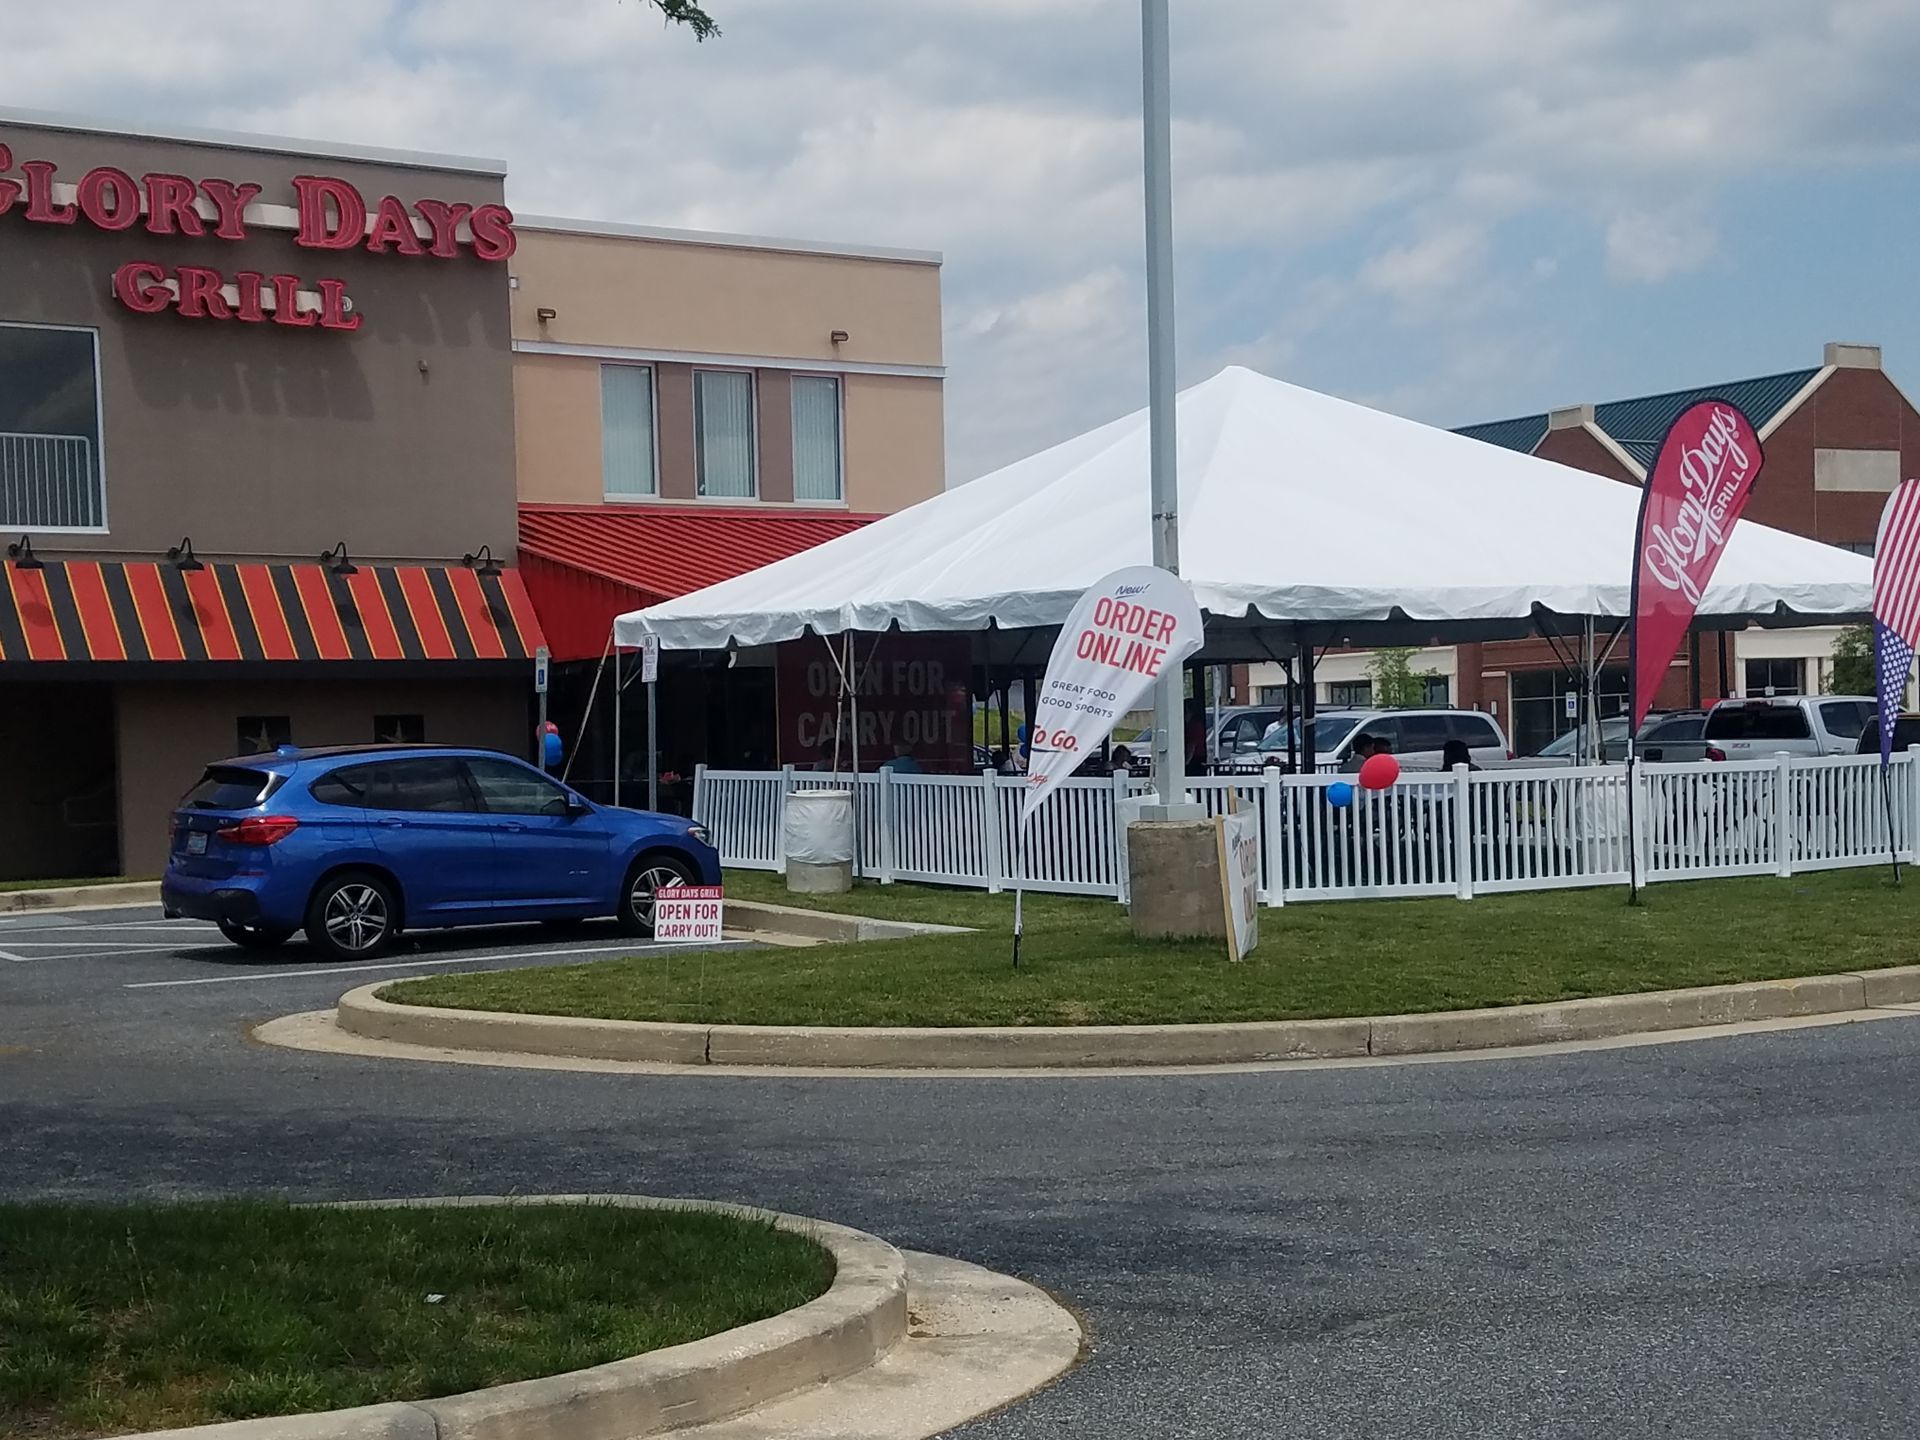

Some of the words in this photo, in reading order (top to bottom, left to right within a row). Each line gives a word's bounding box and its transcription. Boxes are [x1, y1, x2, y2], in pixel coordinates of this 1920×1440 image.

[292, 175, 517, 261] DAYS
[113, 261, 363, 330] GRILL
[1710, 468, 1746, 521] GRILL
[1115, 583, 1151, 597] New!
[1093, 597, 1177, 645] ORDER
[1077, 630, 1167, 678] ONLINE
[893, 660, 945, 696] FOR
[1051, 680, 1086, 694] GREAT
[1087, 688, 1117, 701] FOOD
[1041, 696, 1073, 709] GOOD
[1074, 703, 1114, 719] SPORTS
[902, 709, 957, 746] OUT
[658, 888, 680, 899] GLORY
[681, 888, 699, 899] DAYS
[700, 888, 720, 899] GRILL
[659, 904, 691, 920] OPEN
[695, 904, 718, 920] FOR
[657, 924, 693, 938] CARRY
[694, 924, 718, 938] OUT!
